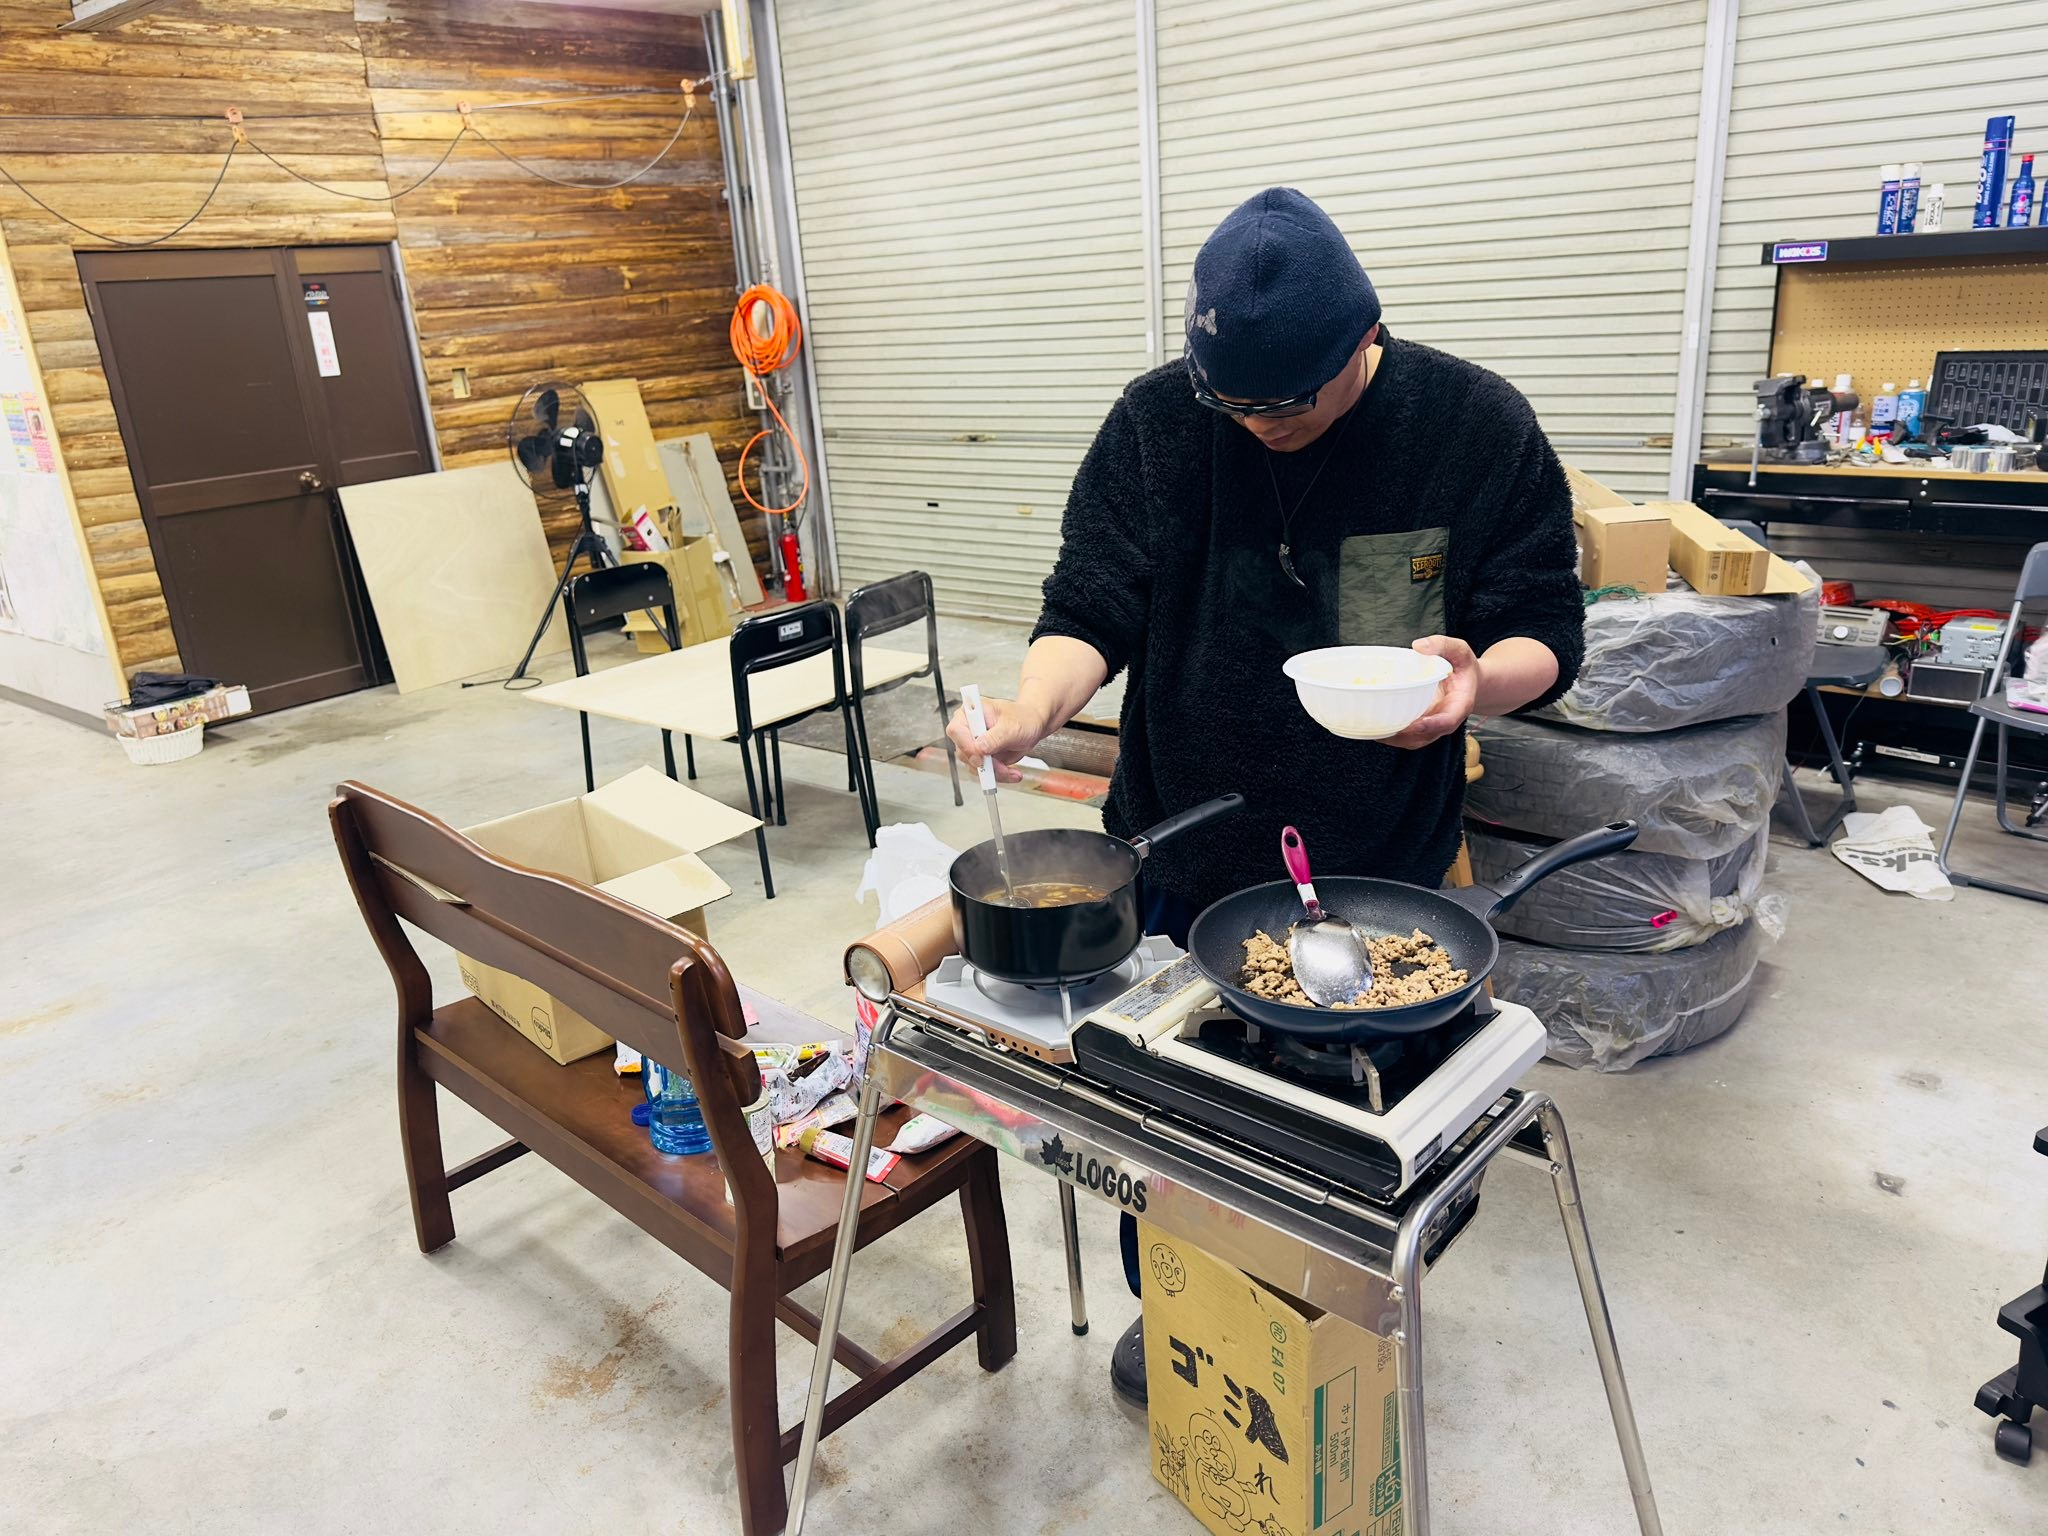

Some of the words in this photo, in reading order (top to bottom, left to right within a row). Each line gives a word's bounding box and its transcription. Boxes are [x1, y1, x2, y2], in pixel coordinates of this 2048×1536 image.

[1075, 1152, 1147, 1213] LOGOS
[1271, 1346, 1285, 1368] EA
[1272, 1371, 1285, 1395] 07
[1329, 1432, 1339, 1467] 500ml
[1339, 1403, 1351, 1483] ホット伊右衛門
[1385, 1466, 1399, 1506] HOT
